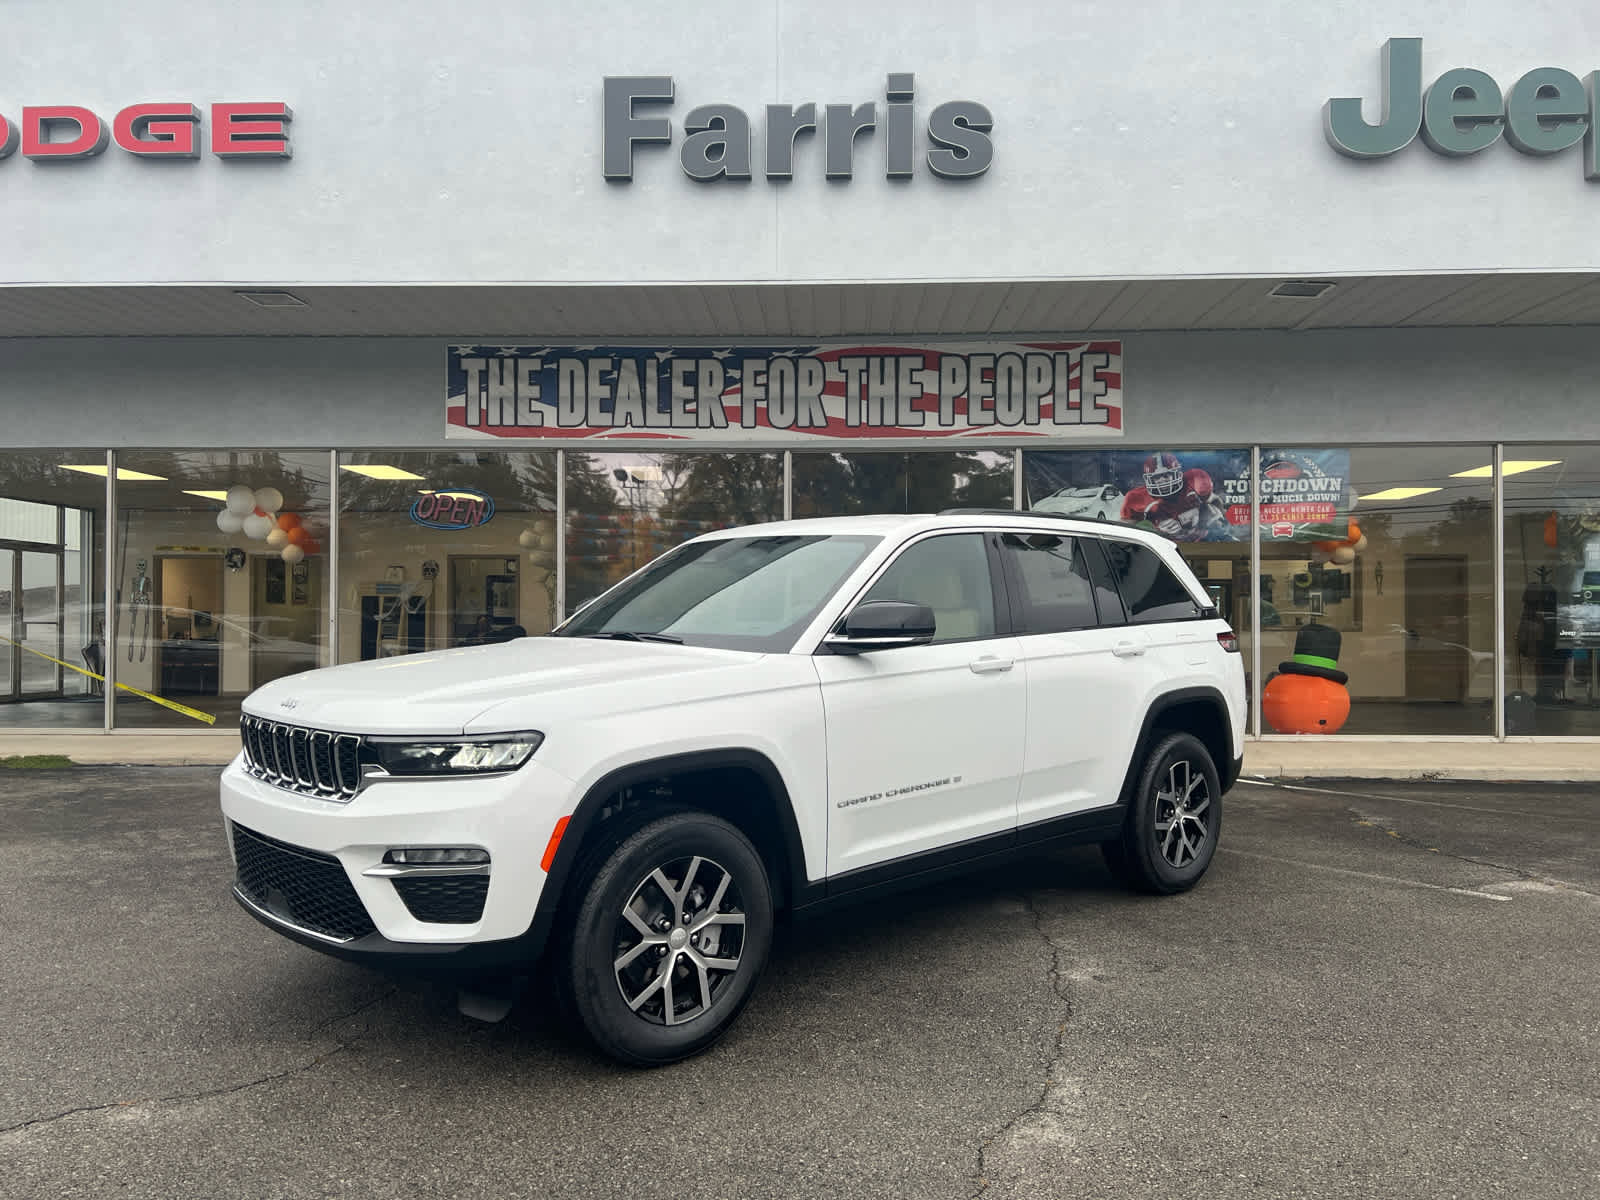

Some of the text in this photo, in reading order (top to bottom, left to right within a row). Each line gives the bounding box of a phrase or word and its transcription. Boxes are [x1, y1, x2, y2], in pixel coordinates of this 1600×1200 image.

[0, 102, 292, 160] DGE
[602, 72, 995, 182] Farris
[460, 351, 1111, 429] THE DEALER FOR THE PEOPLE
[417, 494, 487, 526] OPEN
[1225, 495, 1246, 504] FOR
[1272, 493, 1304, 503] MUCH
[1306, 492, 1341, 502] DOWN!
[837, 777, 951, 809] GRAND CHEROKEE
